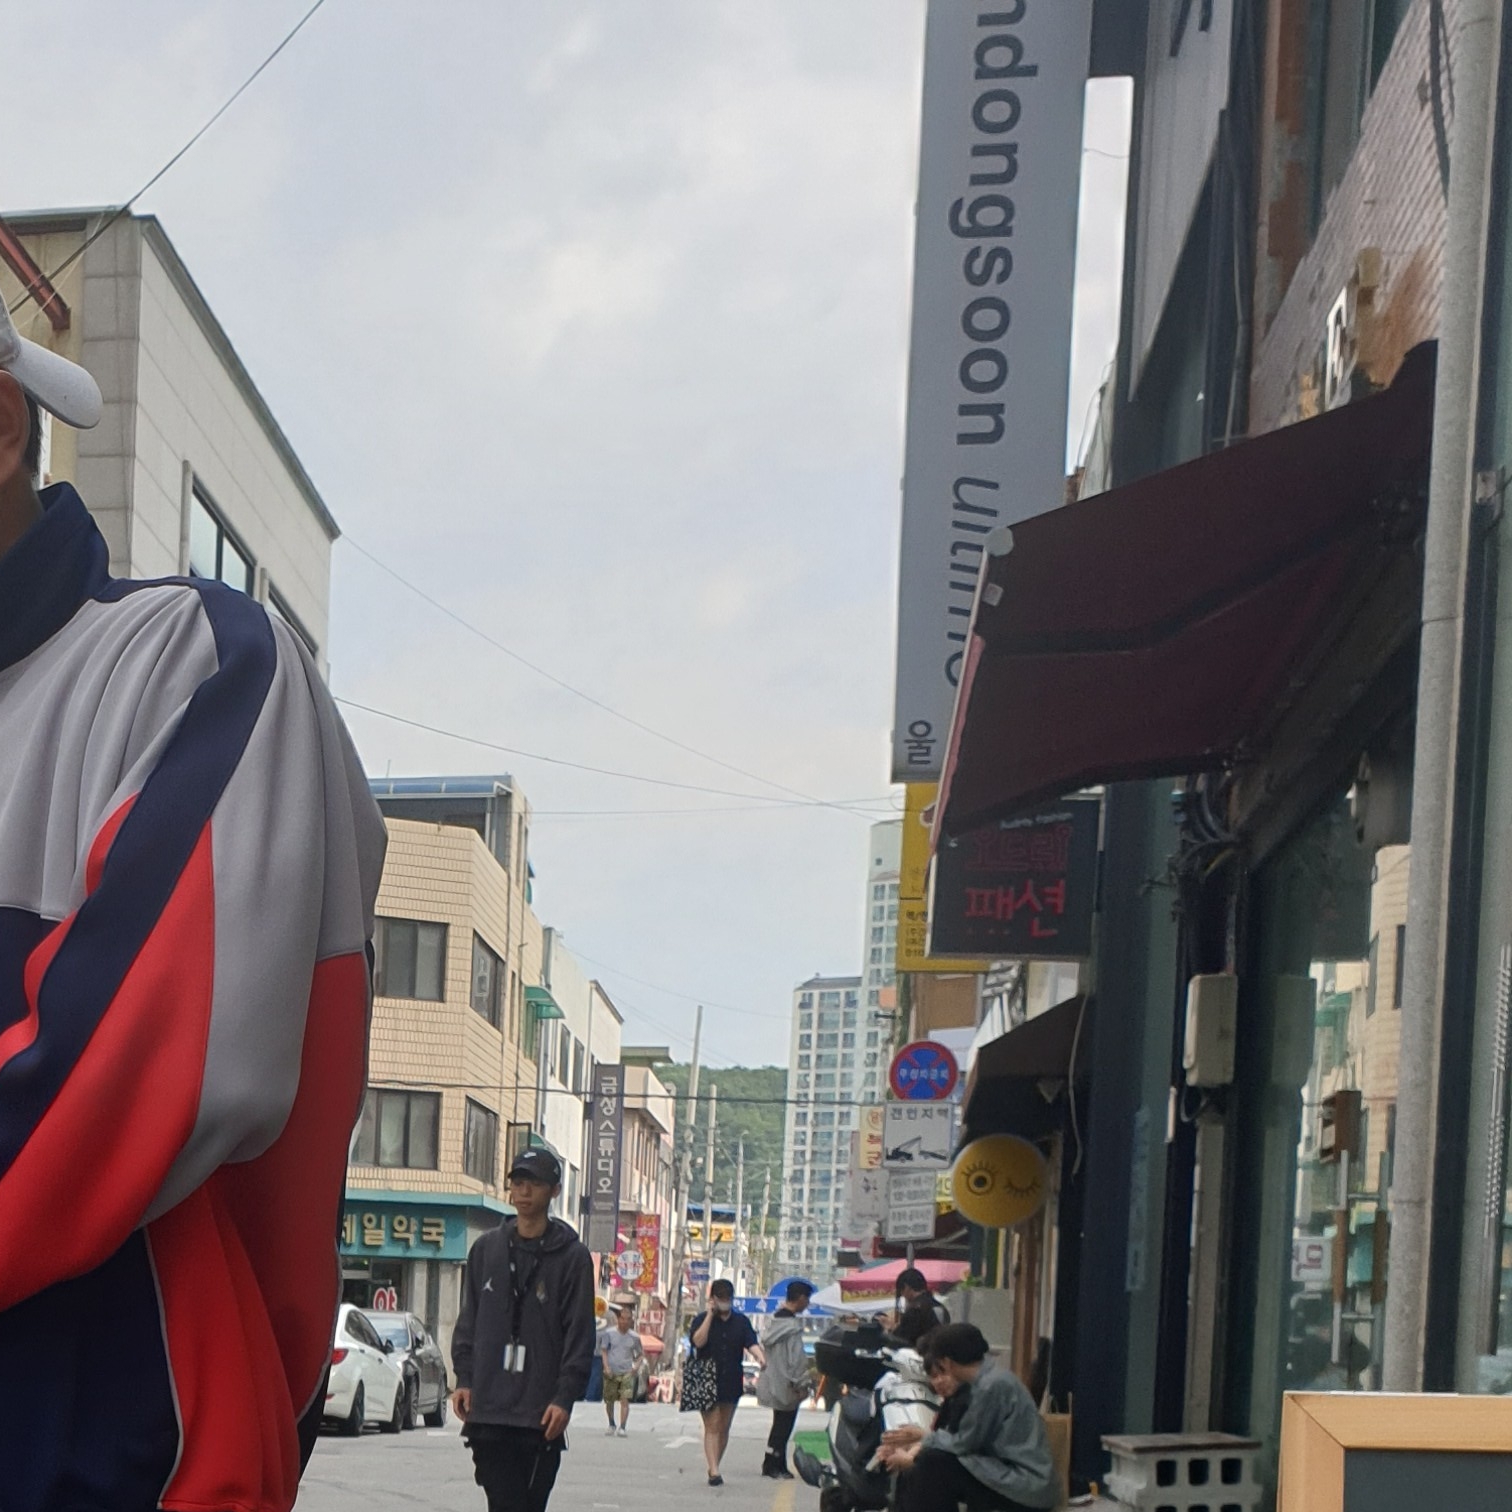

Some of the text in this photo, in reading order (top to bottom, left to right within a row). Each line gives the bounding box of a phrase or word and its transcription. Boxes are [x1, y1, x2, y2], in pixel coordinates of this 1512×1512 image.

[964, 878, 1066, 938] 패션
[596, 1076, 619, 1194] 금성스튜디오
[890, 1106, 949, 1121] 견인지역
